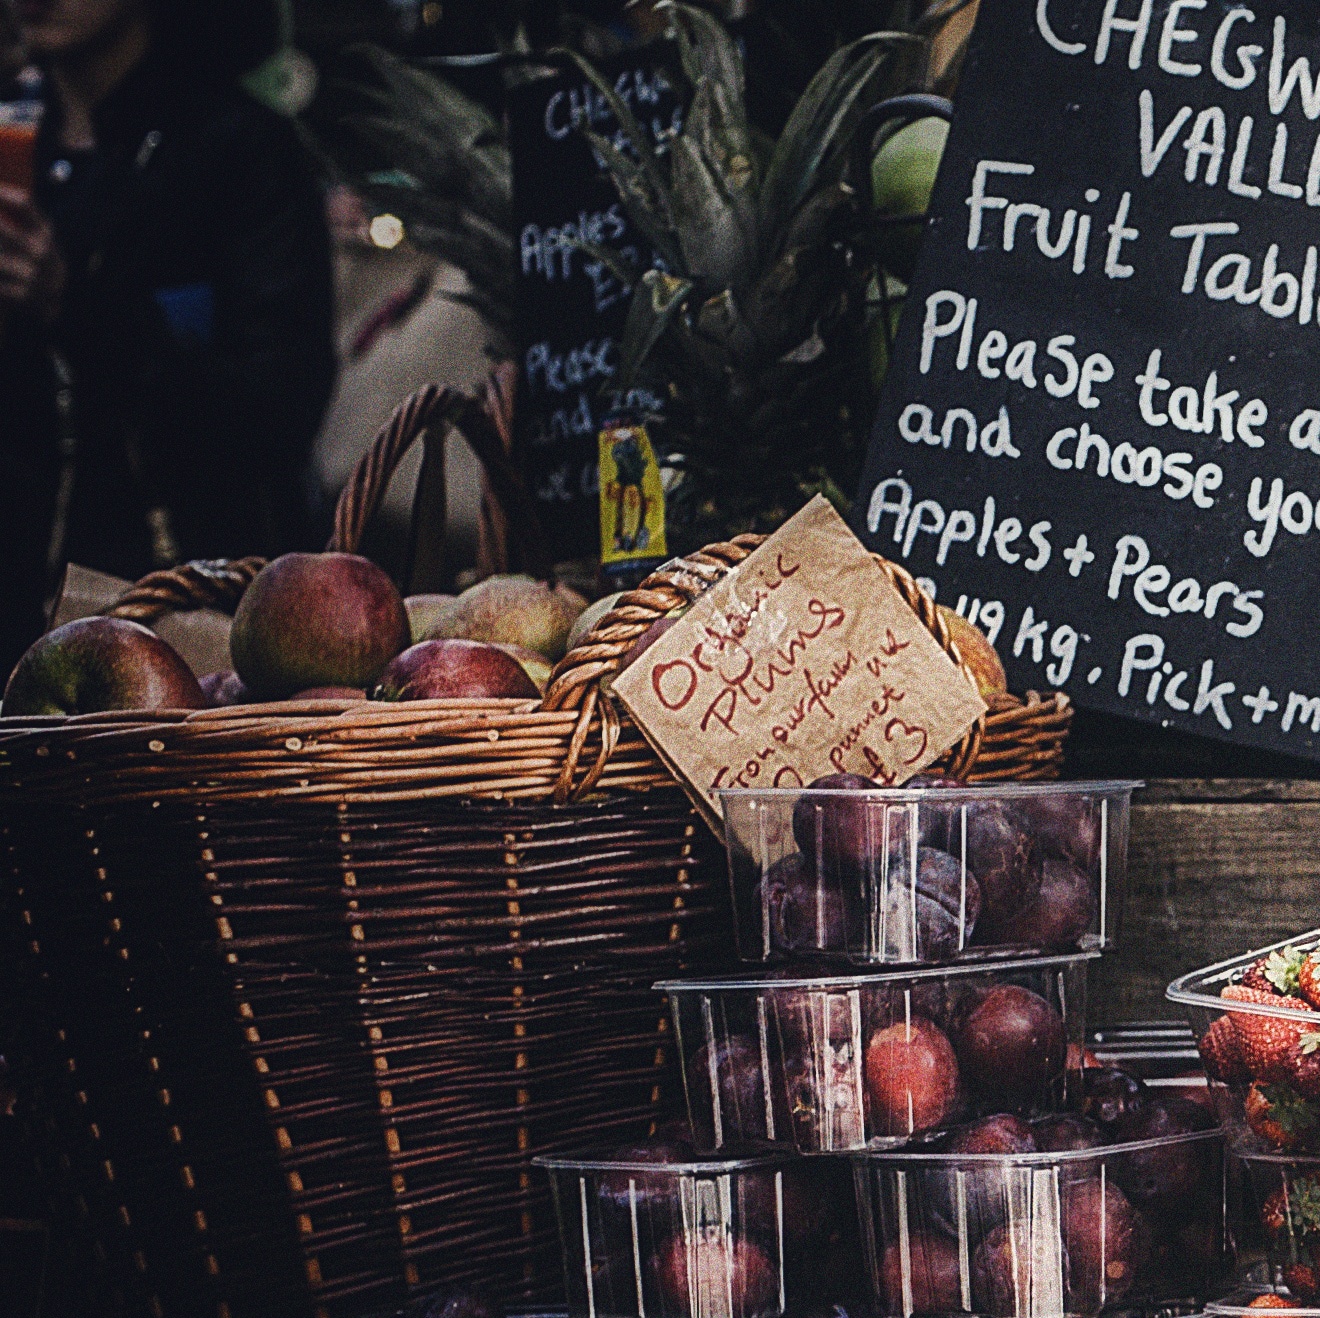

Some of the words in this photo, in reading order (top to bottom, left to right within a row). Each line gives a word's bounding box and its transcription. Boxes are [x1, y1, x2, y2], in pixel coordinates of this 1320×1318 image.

[965, 162, 1136, 278] Fruit
[919, 290, 1115, 408] Please
[1136, 350, 1268, 448] take
[898, 403, 1020, 458] and
[1046, 423, 1224, 510] choose
[867, 478, 1052, 575] Apples
[1107, 535, 1265, 639] Pears
[700, 599, 846, 736] Plums
